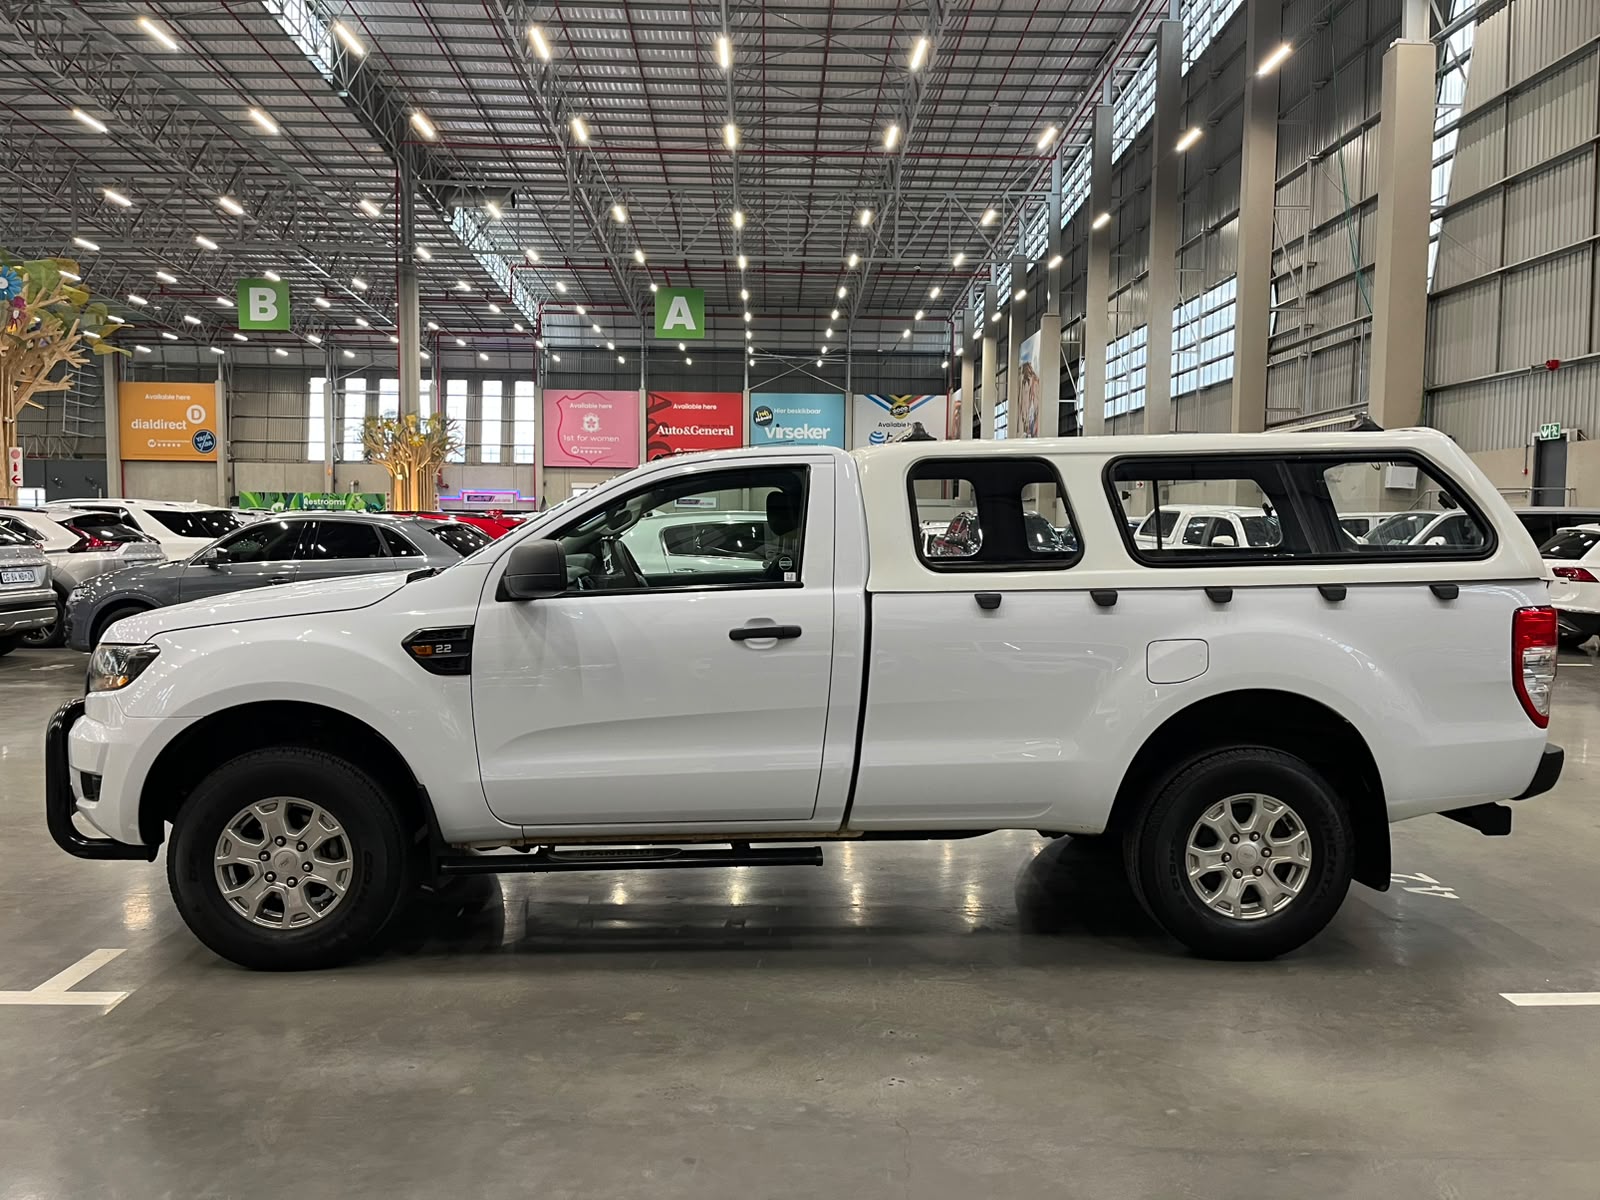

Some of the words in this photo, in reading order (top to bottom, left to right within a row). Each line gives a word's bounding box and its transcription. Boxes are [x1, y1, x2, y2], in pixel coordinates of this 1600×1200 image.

[249, 287, 278, 322] B
[662, 296, 697, 330] A
[176, 393, 191, 401] here
[190, 408, 202, 420] D
[131, 419, 187, 430] dialdirect
[656, 425, 734, 436] Auto&General
[764, 423, 831, 440] virseker
[303, 497, 346, 506] Restrooms
